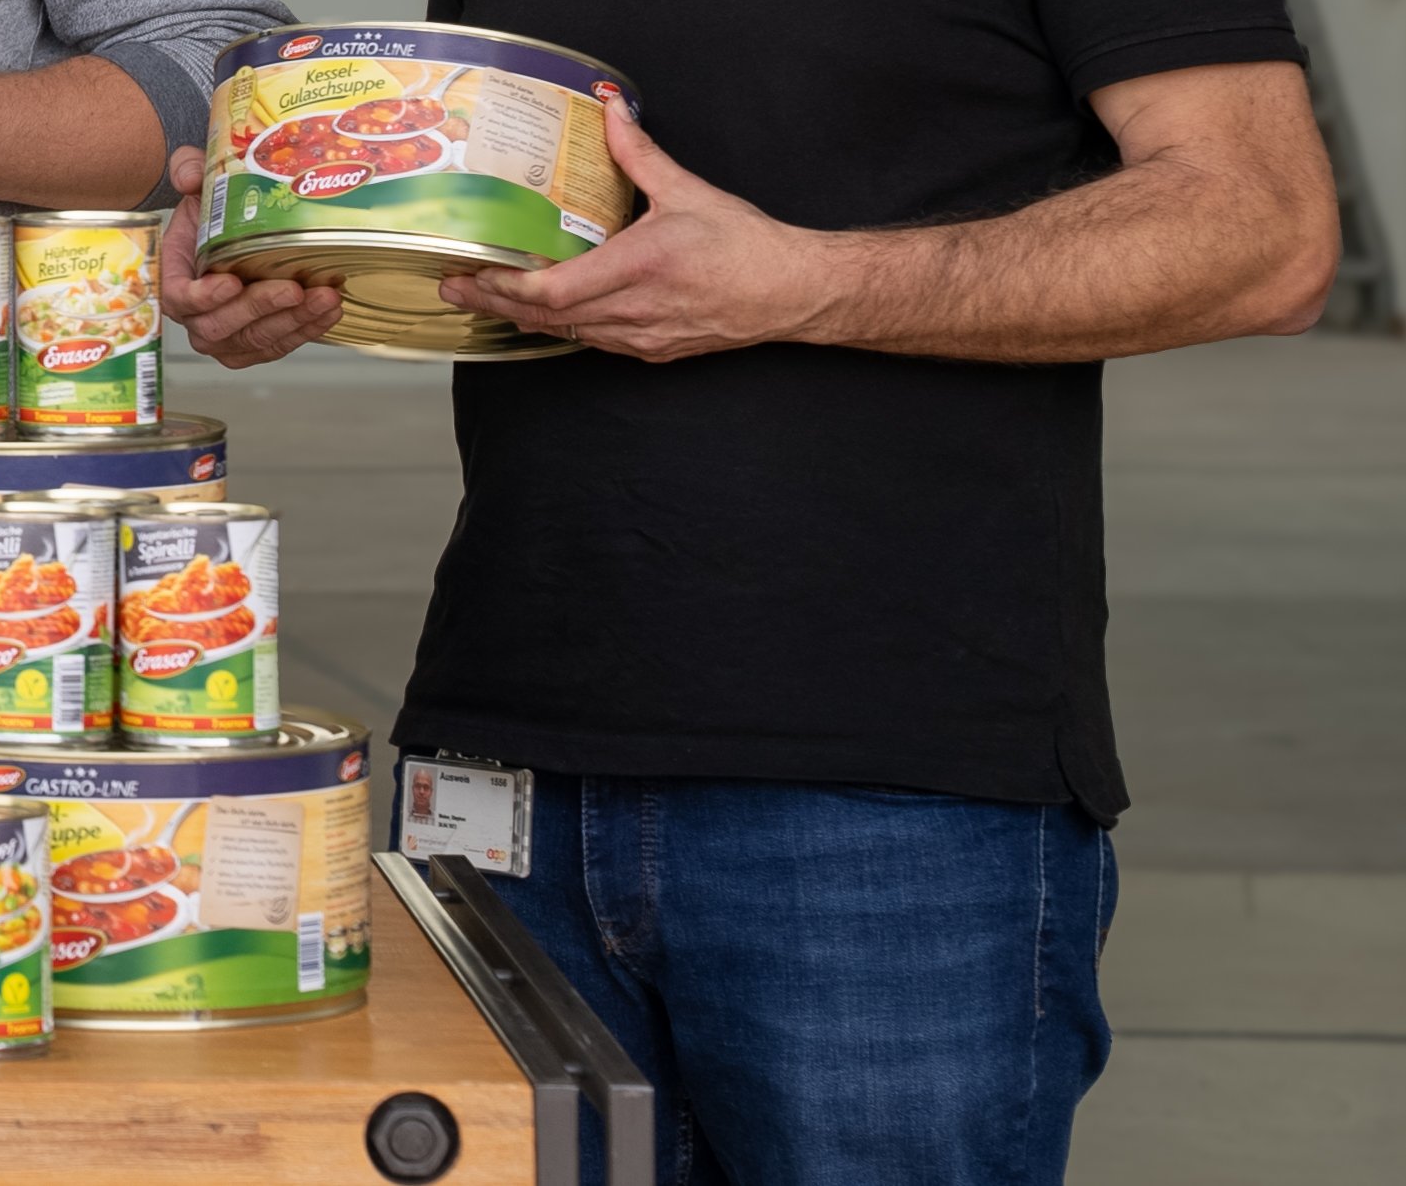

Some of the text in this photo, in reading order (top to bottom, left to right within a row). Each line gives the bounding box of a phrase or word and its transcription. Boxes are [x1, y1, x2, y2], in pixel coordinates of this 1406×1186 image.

[283, 38, 416, 57] Erasco GASTRO-LINE
[305, 63, 359, 85] Kessel-
[279, 78, 386, 109] Gulaschsuppe
[298, 169, 366, 195] Erasco
[44, 245, 90, 261] Hühner
[43, 345, 106, 369] Erasco
[137, 538, 196, 561] Spirelli
[133, 650, 195, 673] Erasco
[26, 776, 139, 797] GASTRO-LINE
[52, 934, 96, 961] asco
